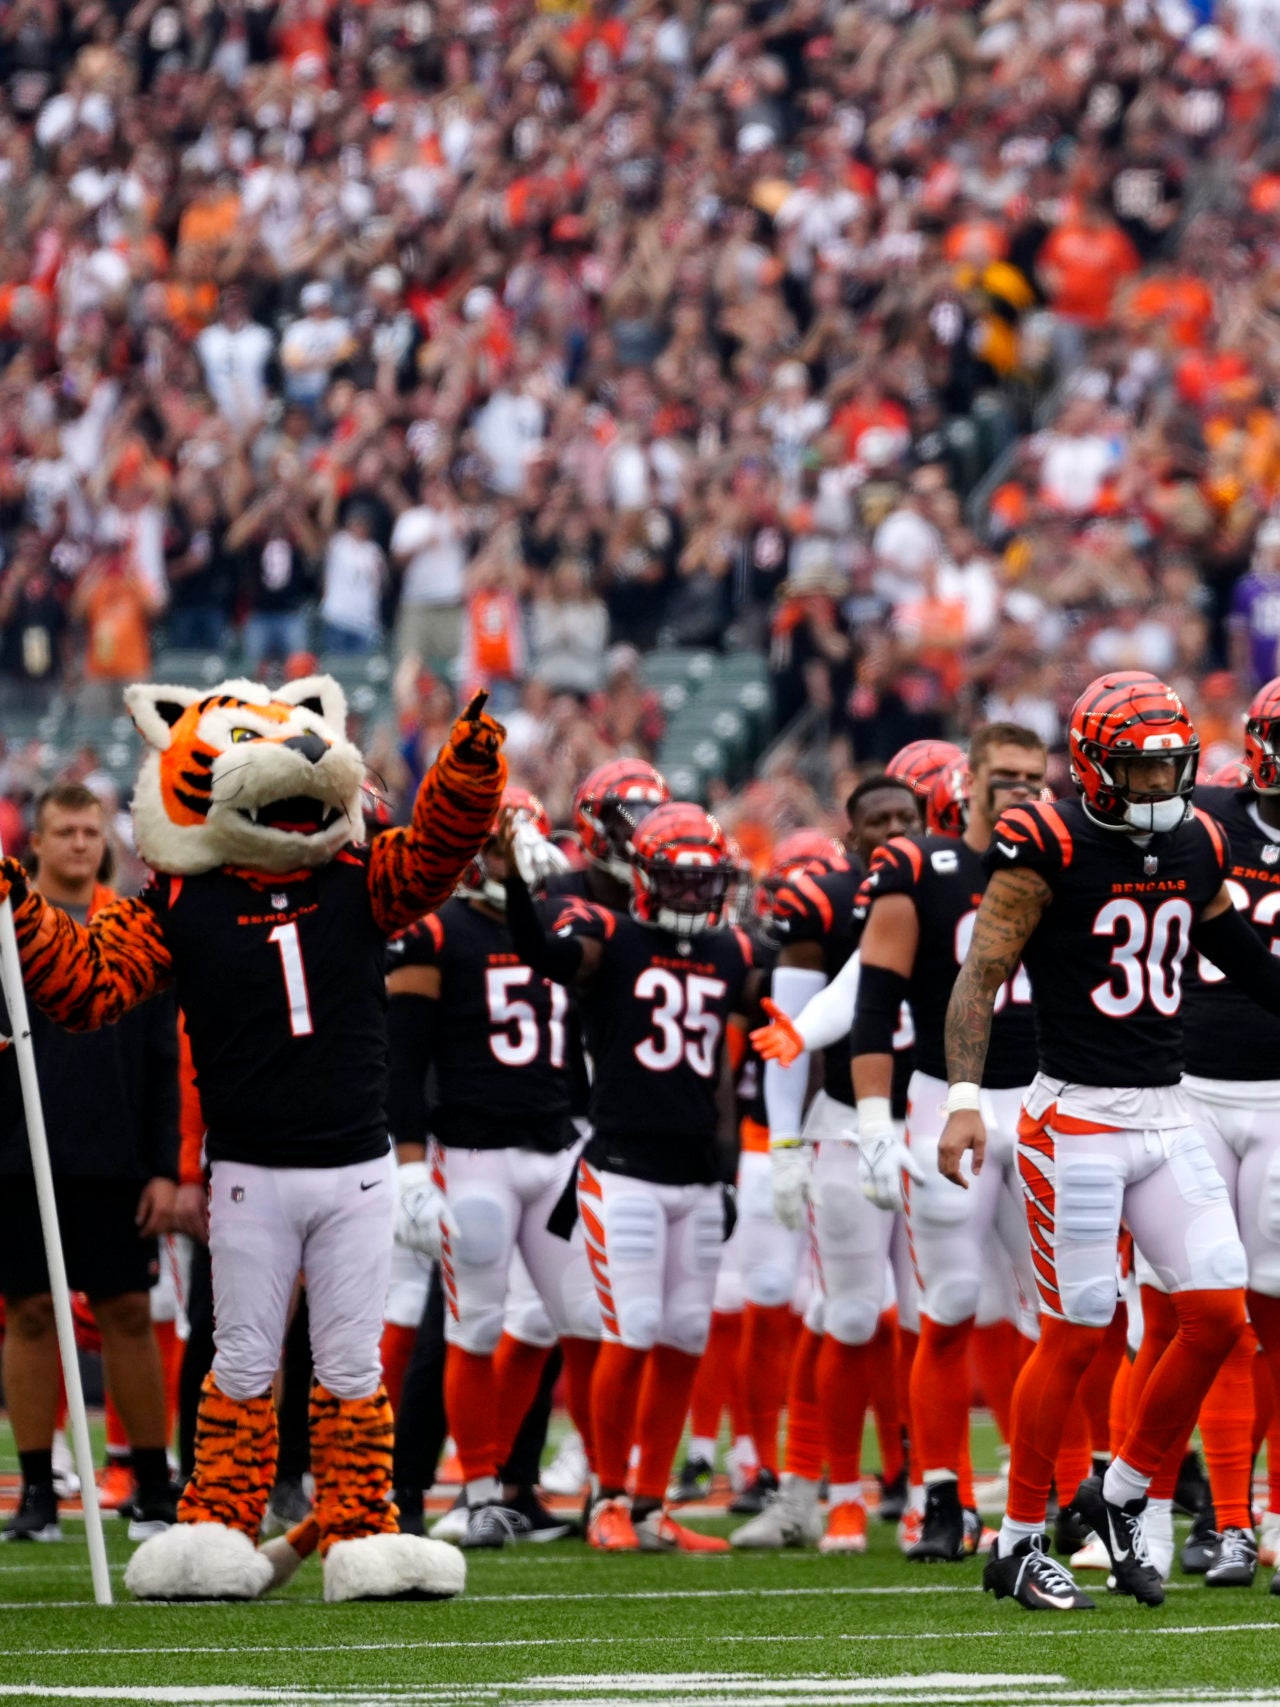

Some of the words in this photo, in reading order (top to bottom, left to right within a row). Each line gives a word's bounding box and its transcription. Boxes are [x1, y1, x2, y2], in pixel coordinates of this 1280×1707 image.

[1112, 879, 1187, 893] BENGALS
[267, 920, 314, 1038] 1
[1090, 896, 1193, 1018] 30
[485, 964, 569, 1069] 51
[634, 966, 727, 1079] 35
